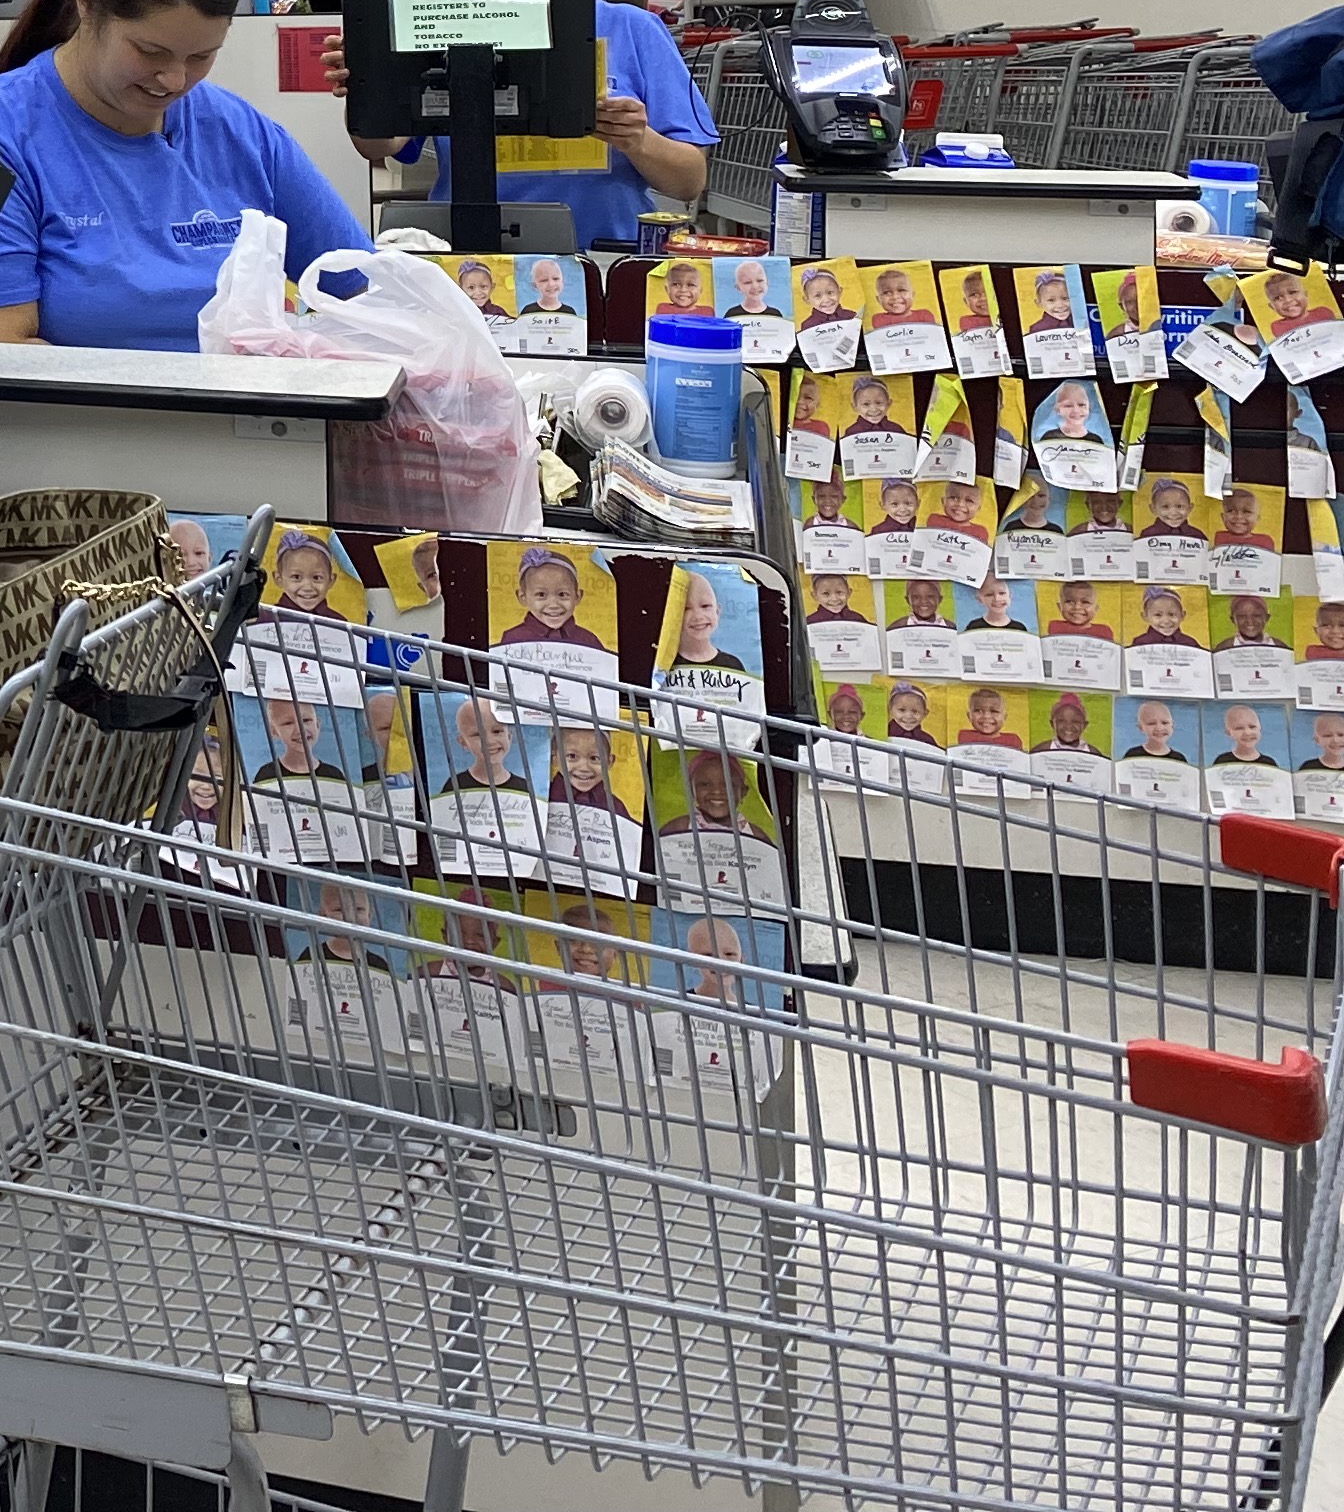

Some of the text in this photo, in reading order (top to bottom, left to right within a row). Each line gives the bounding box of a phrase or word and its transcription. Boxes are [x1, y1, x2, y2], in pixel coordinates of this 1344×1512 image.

[412, 2, 469, 11] REGISTERS
[413, 11, 520, 21] PURCHASE ALCOHOL
[815, 324, 843, 336] Sarah
[936, 532, 971, 548] Kathy
[586, 836, 611, 846] Aspen
